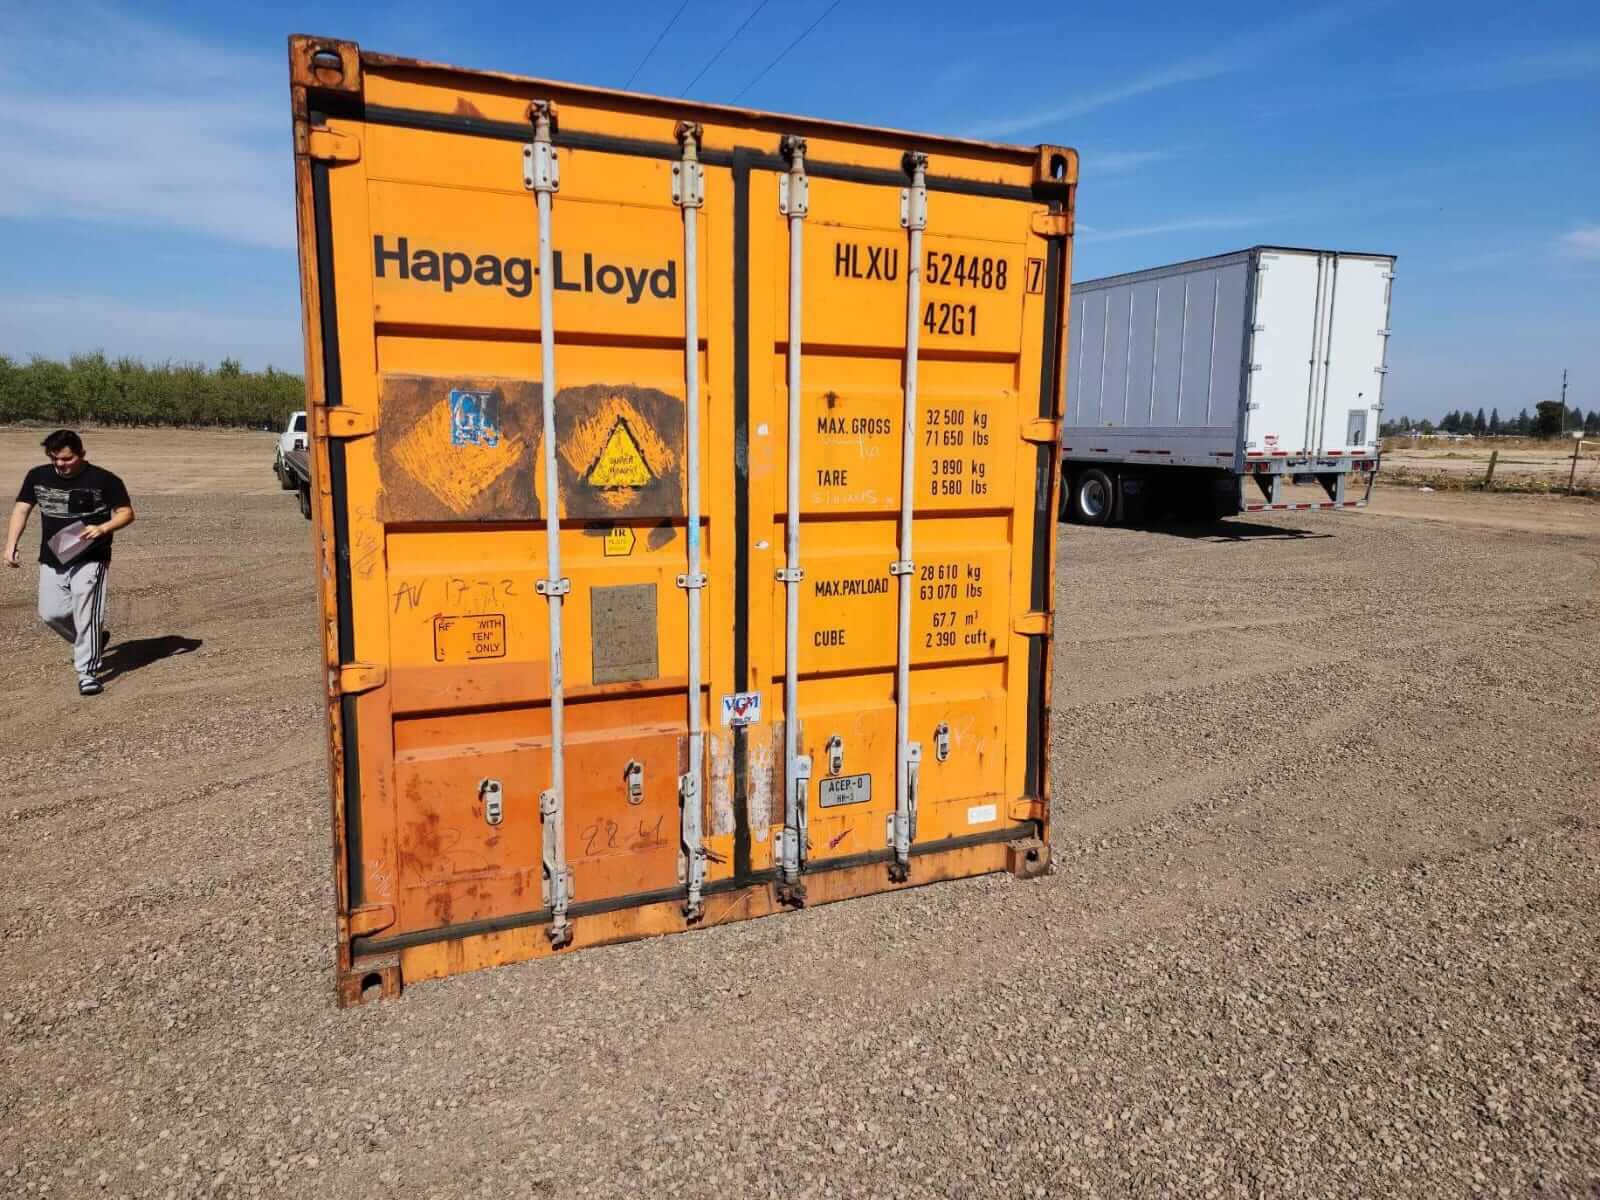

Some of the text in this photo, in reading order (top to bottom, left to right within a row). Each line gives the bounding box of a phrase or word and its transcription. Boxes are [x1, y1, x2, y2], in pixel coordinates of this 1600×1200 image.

[835, 243, 1041, 291] HLXU 524488 7
[923, 302, 977, 336] 42G1
[851, 418, 891, 434] GROSS
[973, 411, 987, 428] kg
[972, 431, 989, 446] lbs
[971, 460, 985, 477] kg
[817, 470, 848, 486] TARE
[971, 481, 987, 495] lbs
[967, 564, 981, 580] kg
[966, 584, 982, 598] lbs
[814, 629, 846, 647] CUBE
[476, 643, 499, 653] ONLY
[725, 695, 759, 711] VGM
